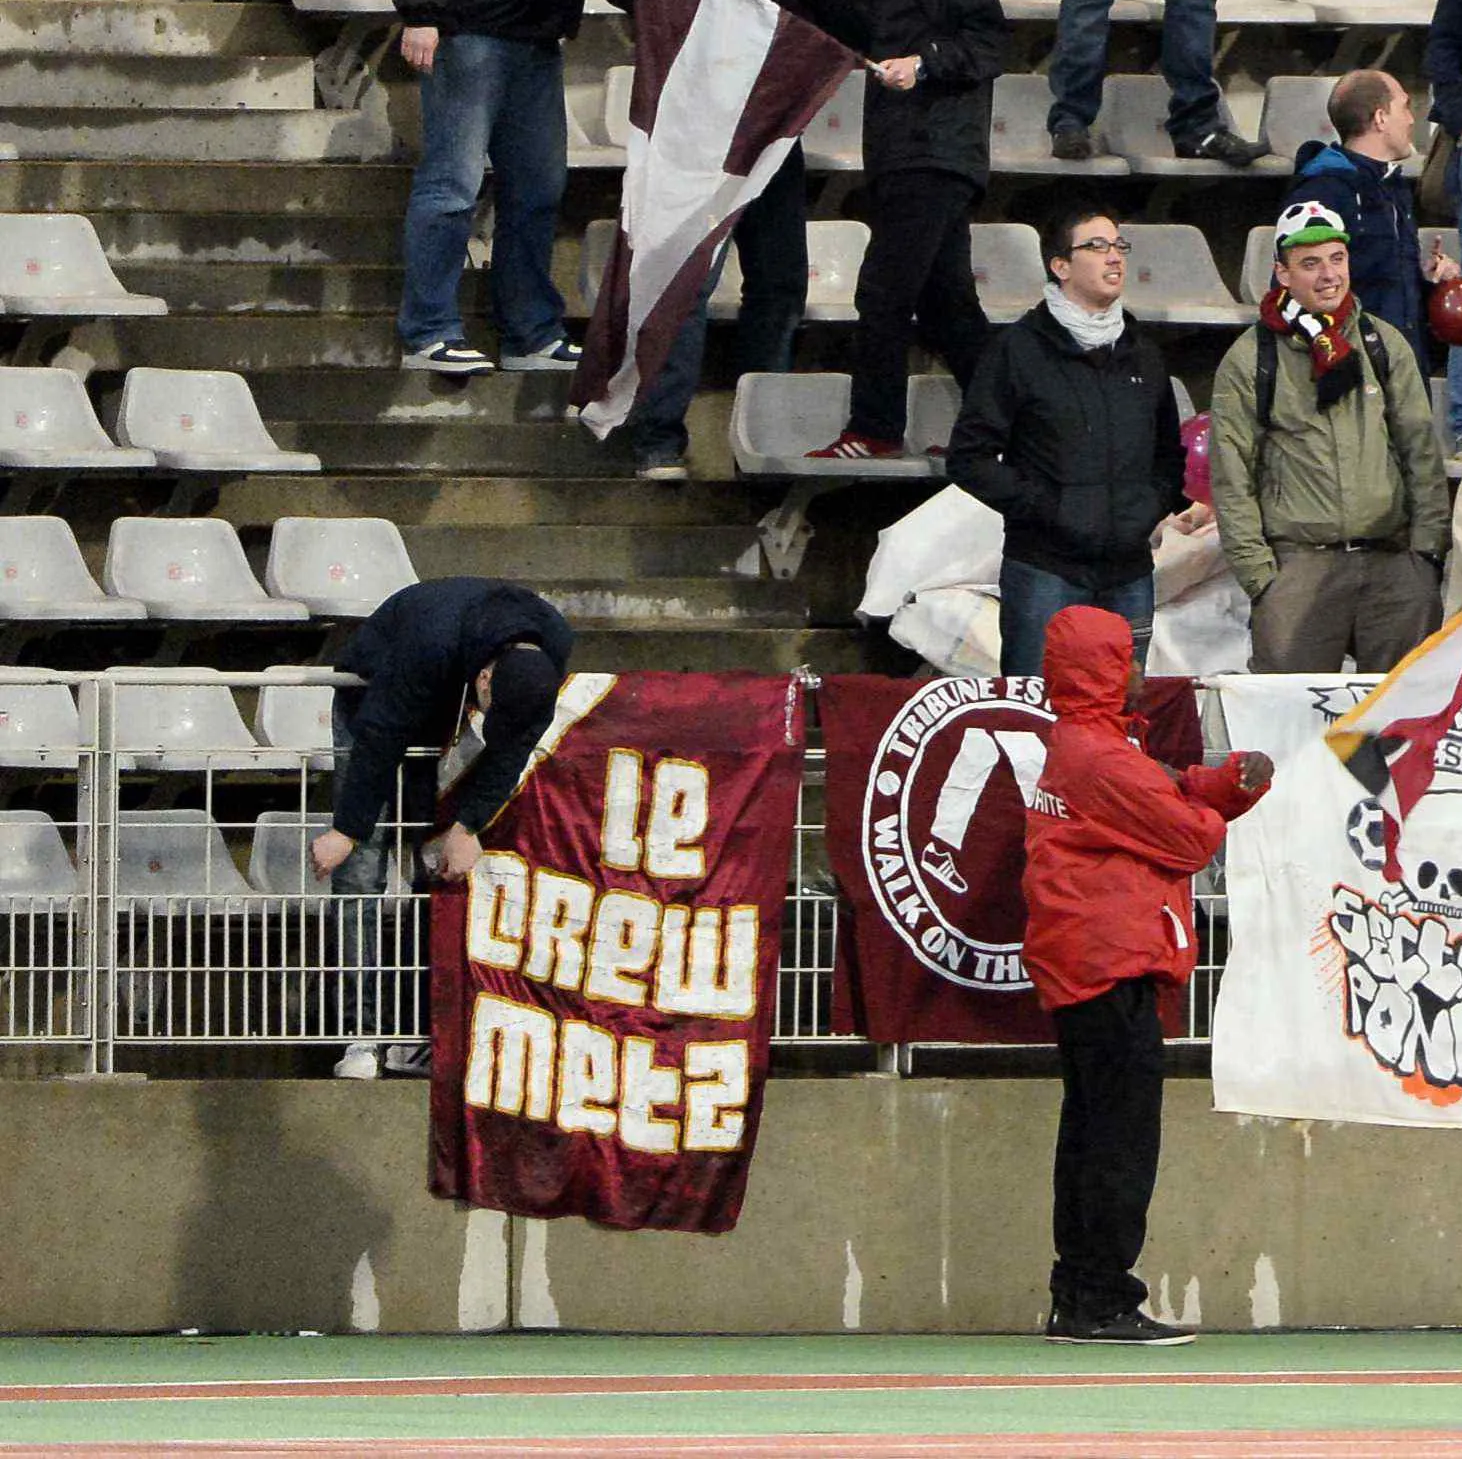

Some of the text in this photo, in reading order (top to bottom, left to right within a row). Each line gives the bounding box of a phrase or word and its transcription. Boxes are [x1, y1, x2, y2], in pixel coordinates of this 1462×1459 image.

[886, 677, 1053, 759] TRIBUNE ES
[1034, 787, 1071, 820] RITE
[874, 815, 1034, 981] WALK ON TH
